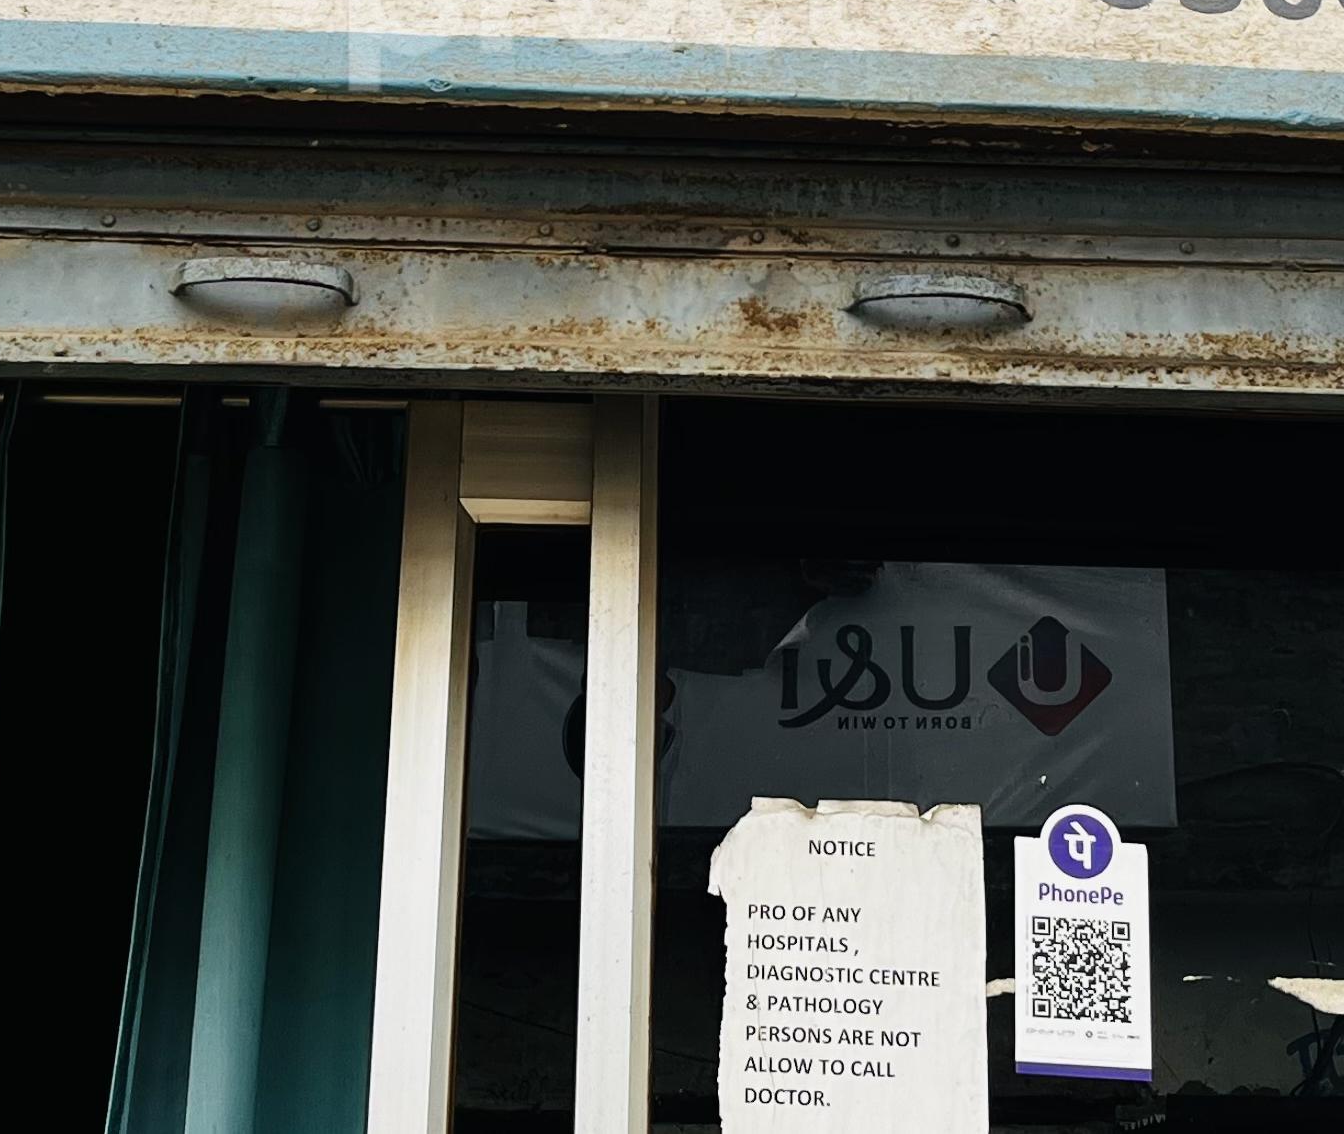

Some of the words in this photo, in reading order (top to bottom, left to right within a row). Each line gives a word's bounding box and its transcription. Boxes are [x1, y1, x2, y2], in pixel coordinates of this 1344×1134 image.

[808, 839, 876, 858] NOTICE
[1039, 882, 1124, 906] PhonePe
[748, 903, 787, 921] PRO
[792, 905, 817, 922] OF
[821, 906, 862, 924] ANY
[747, 964, 864, 985] DIAGNOSTIC
[869, 967, 941, 988] CENTRE
[746, 994, 759, 1011] &
[767, 995, 884, 1016] PATHOLOGY
[745, 1025, 833, 1045] PERSONS
[838, 1028, 875, 1046] ARE
[880, 1030, 922, 1048] NOT
[744, 1056, 813, 1076] ALLOW
[819, 1059, 845, 1077] TO
[850, 1061, 896, 1079] CALL
[744, 1087, 831, 1107] DOCTOR.
